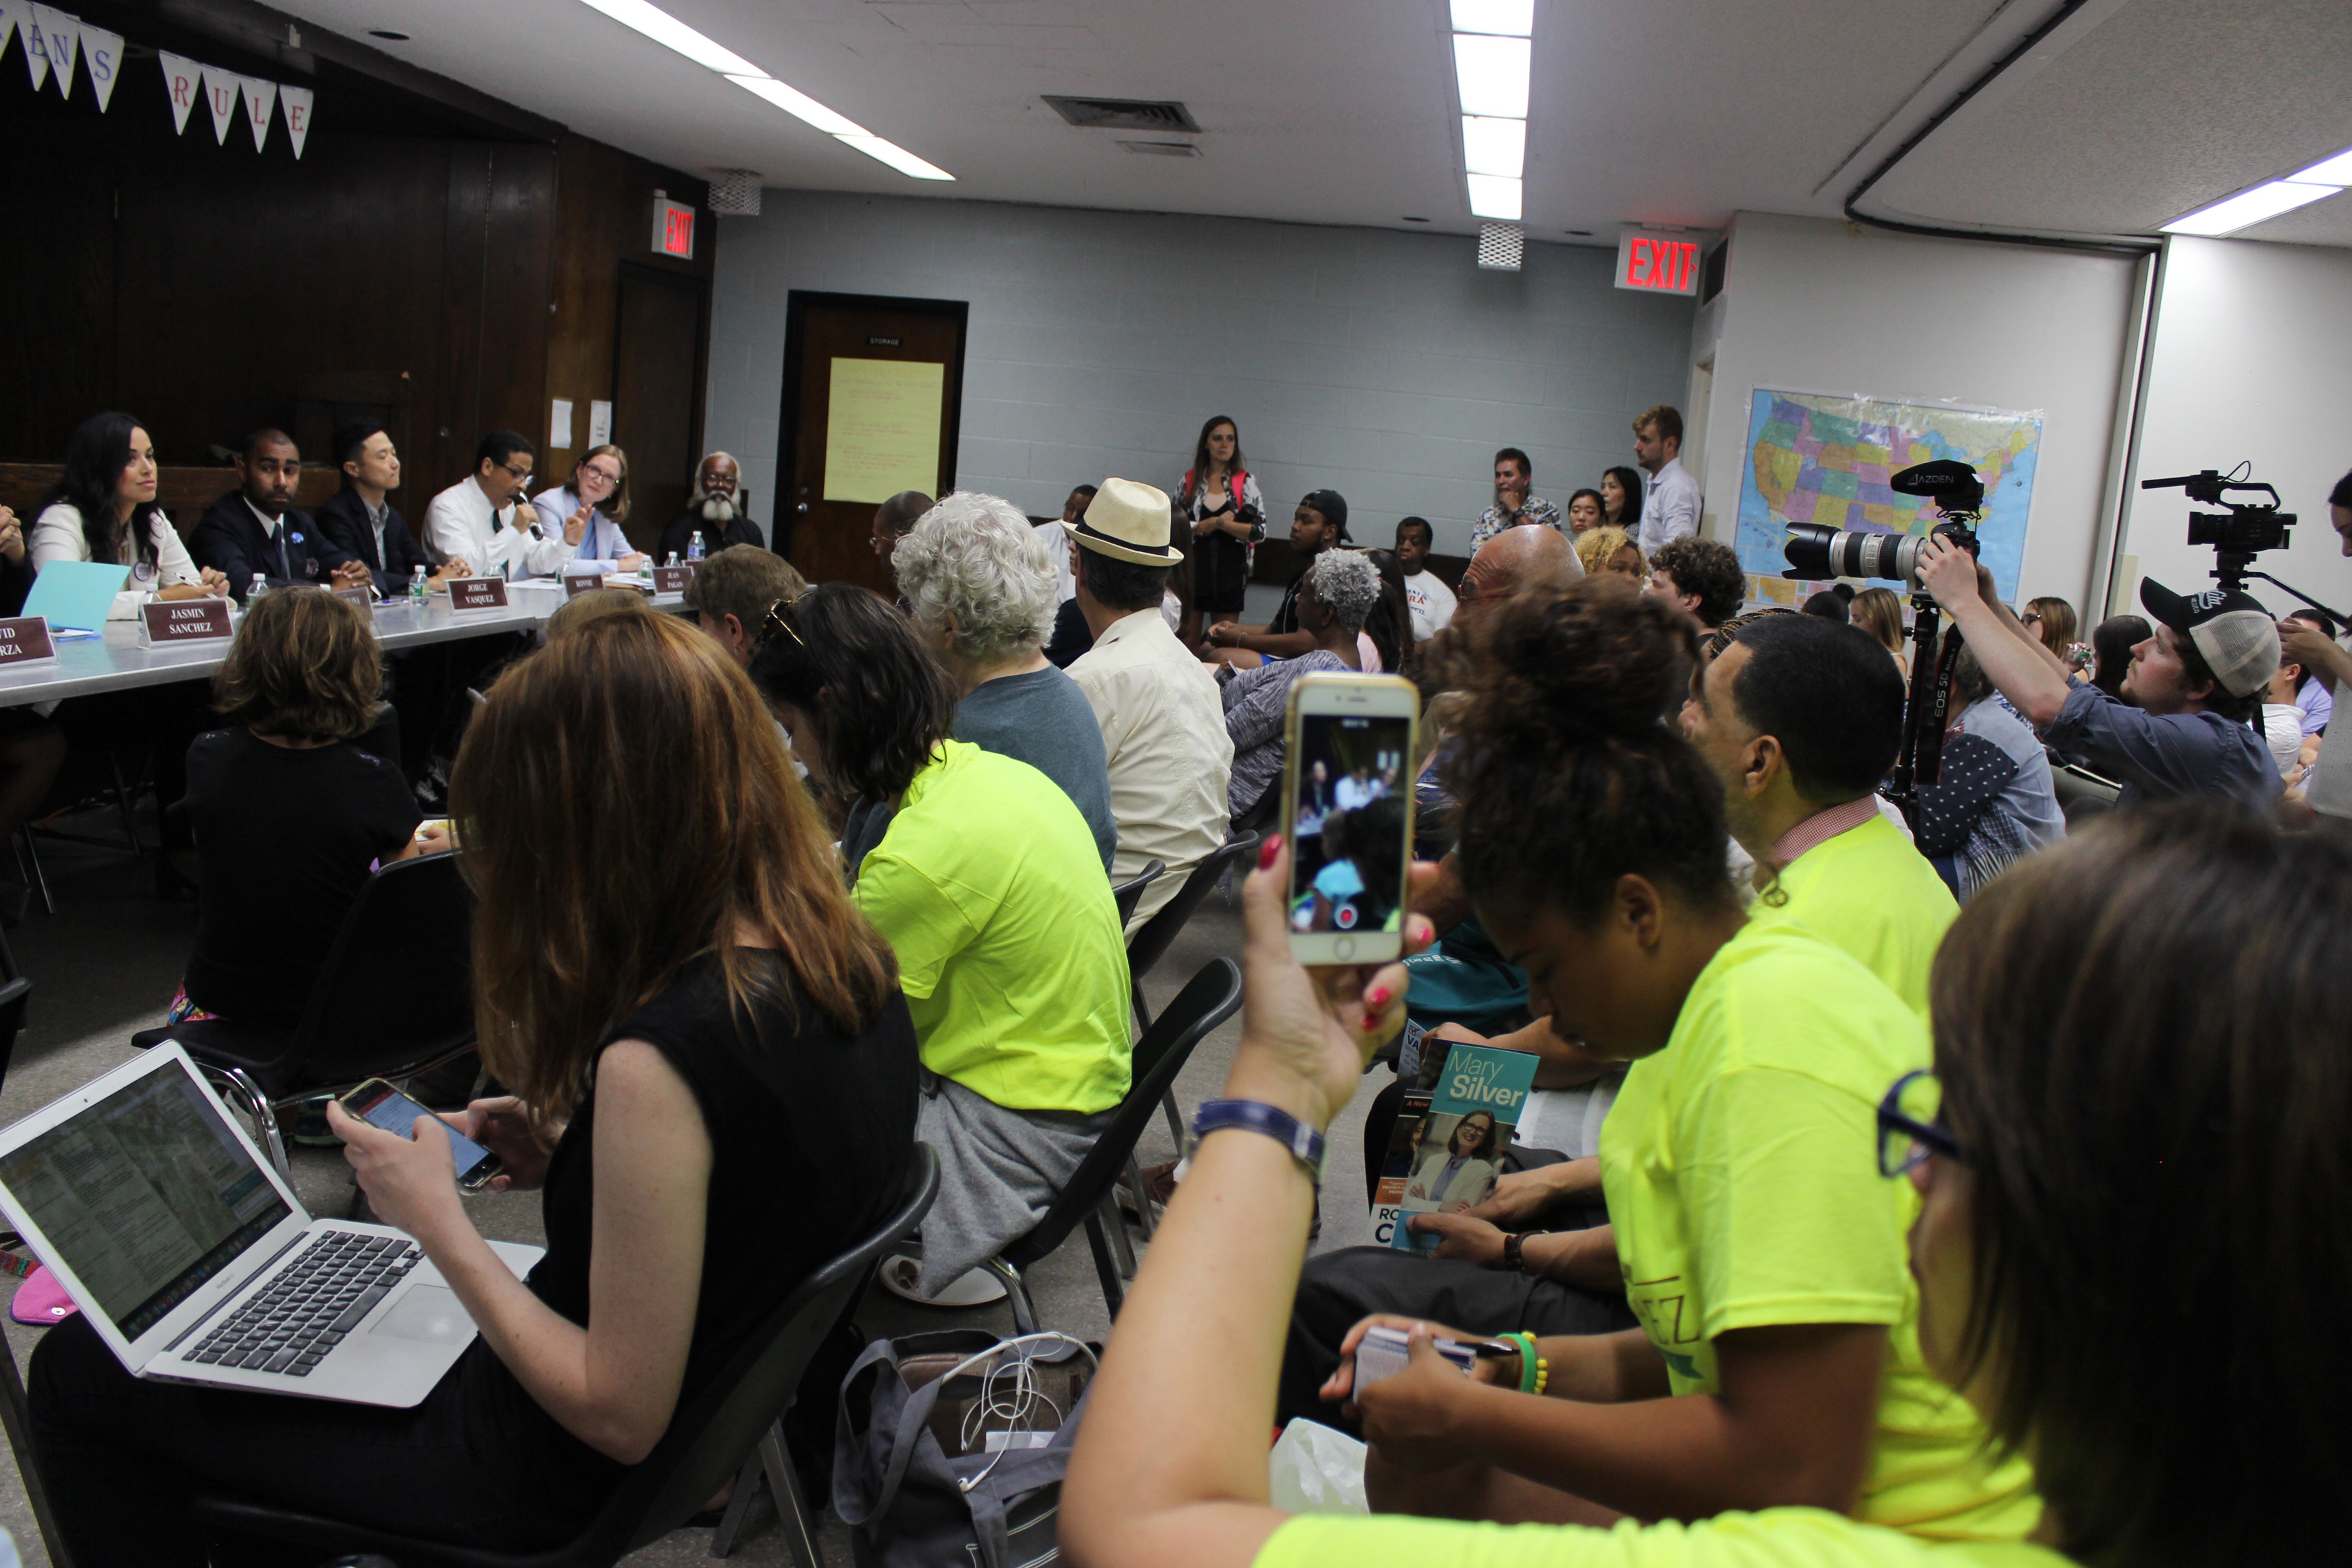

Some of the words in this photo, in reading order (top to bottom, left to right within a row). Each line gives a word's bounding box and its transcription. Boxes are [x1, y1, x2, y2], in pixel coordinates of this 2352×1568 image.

[174, 76, 305, 133] RULE
[666, 207, 693, 255] EXIT
[1626, 238, 1697, 291] EXIT
[870, 337, 900, 346] STORAGE
[1918, 475, 1954, 483] AZDEN
[467, 583, 488, 593] JORGE
[465, 595, 495, 606] VASQUEZ
[2191, 597, 2200, 613] MEXICO
[171, 608, 205, 620] JASMIN
[169, 622, 213, 634] SANCHEZ
[1944, 653, 1956, 672] Mark
[1939, 672, 1949, 687] 5D
[1934, 690, 1947, 718] EOS
[1448, 1051, 1504, 1086] Mary
[1449, 1074, 1524, 1107] Silver
[1375, 1222, 1395, 1244] C
